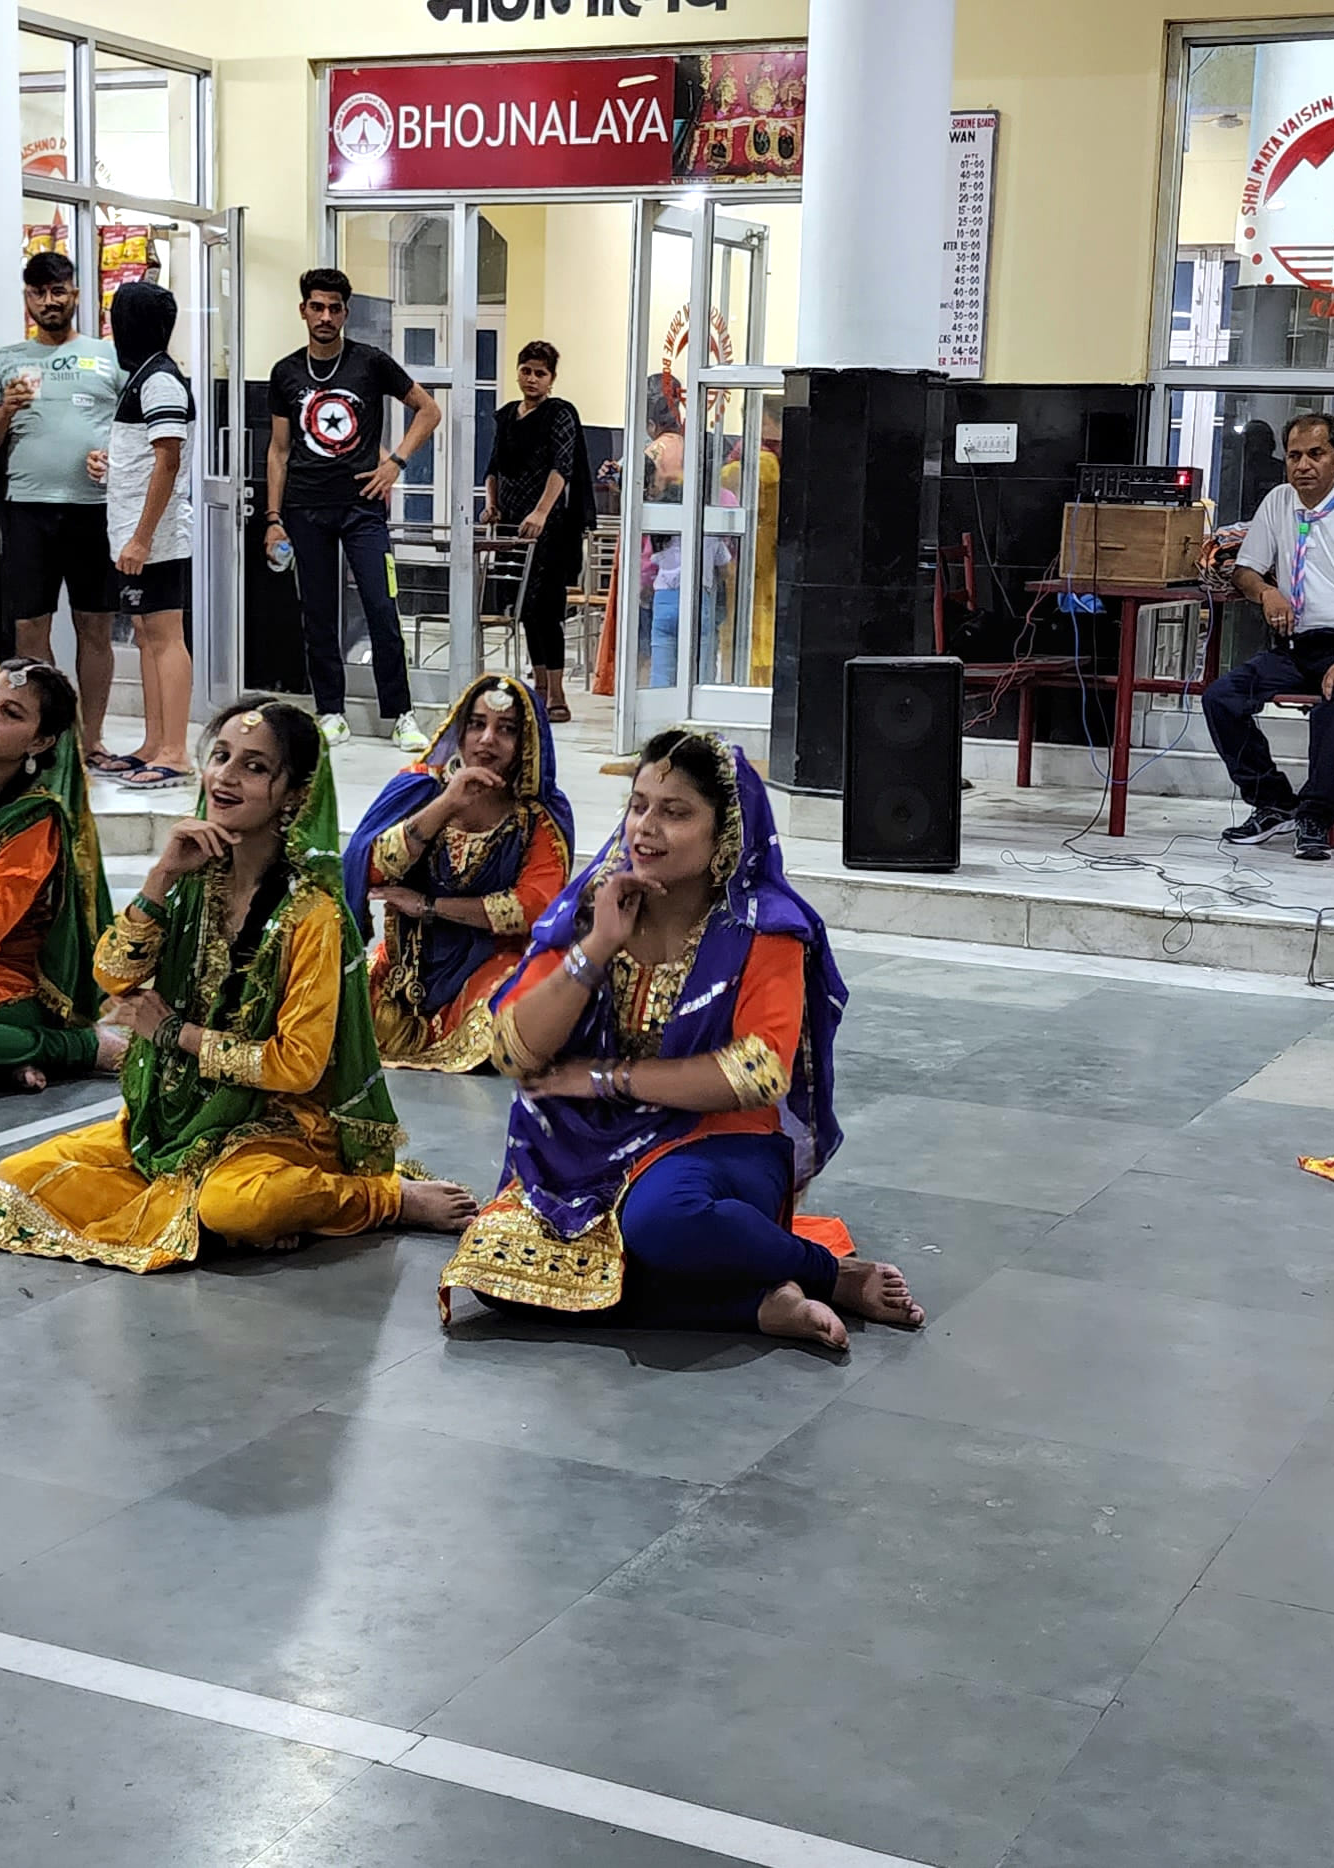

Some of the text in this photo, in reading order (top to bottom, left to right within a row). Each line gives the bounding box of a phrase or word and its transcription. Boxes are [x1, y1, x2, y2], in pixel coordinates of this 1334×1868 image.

[398, 97, 669, 149] BHOJNALAYA
[948, 130, 976, 144] WAN
[1251, 136, 1284, 176] MATA
[1242, 177, 1262, 217] SHRI
